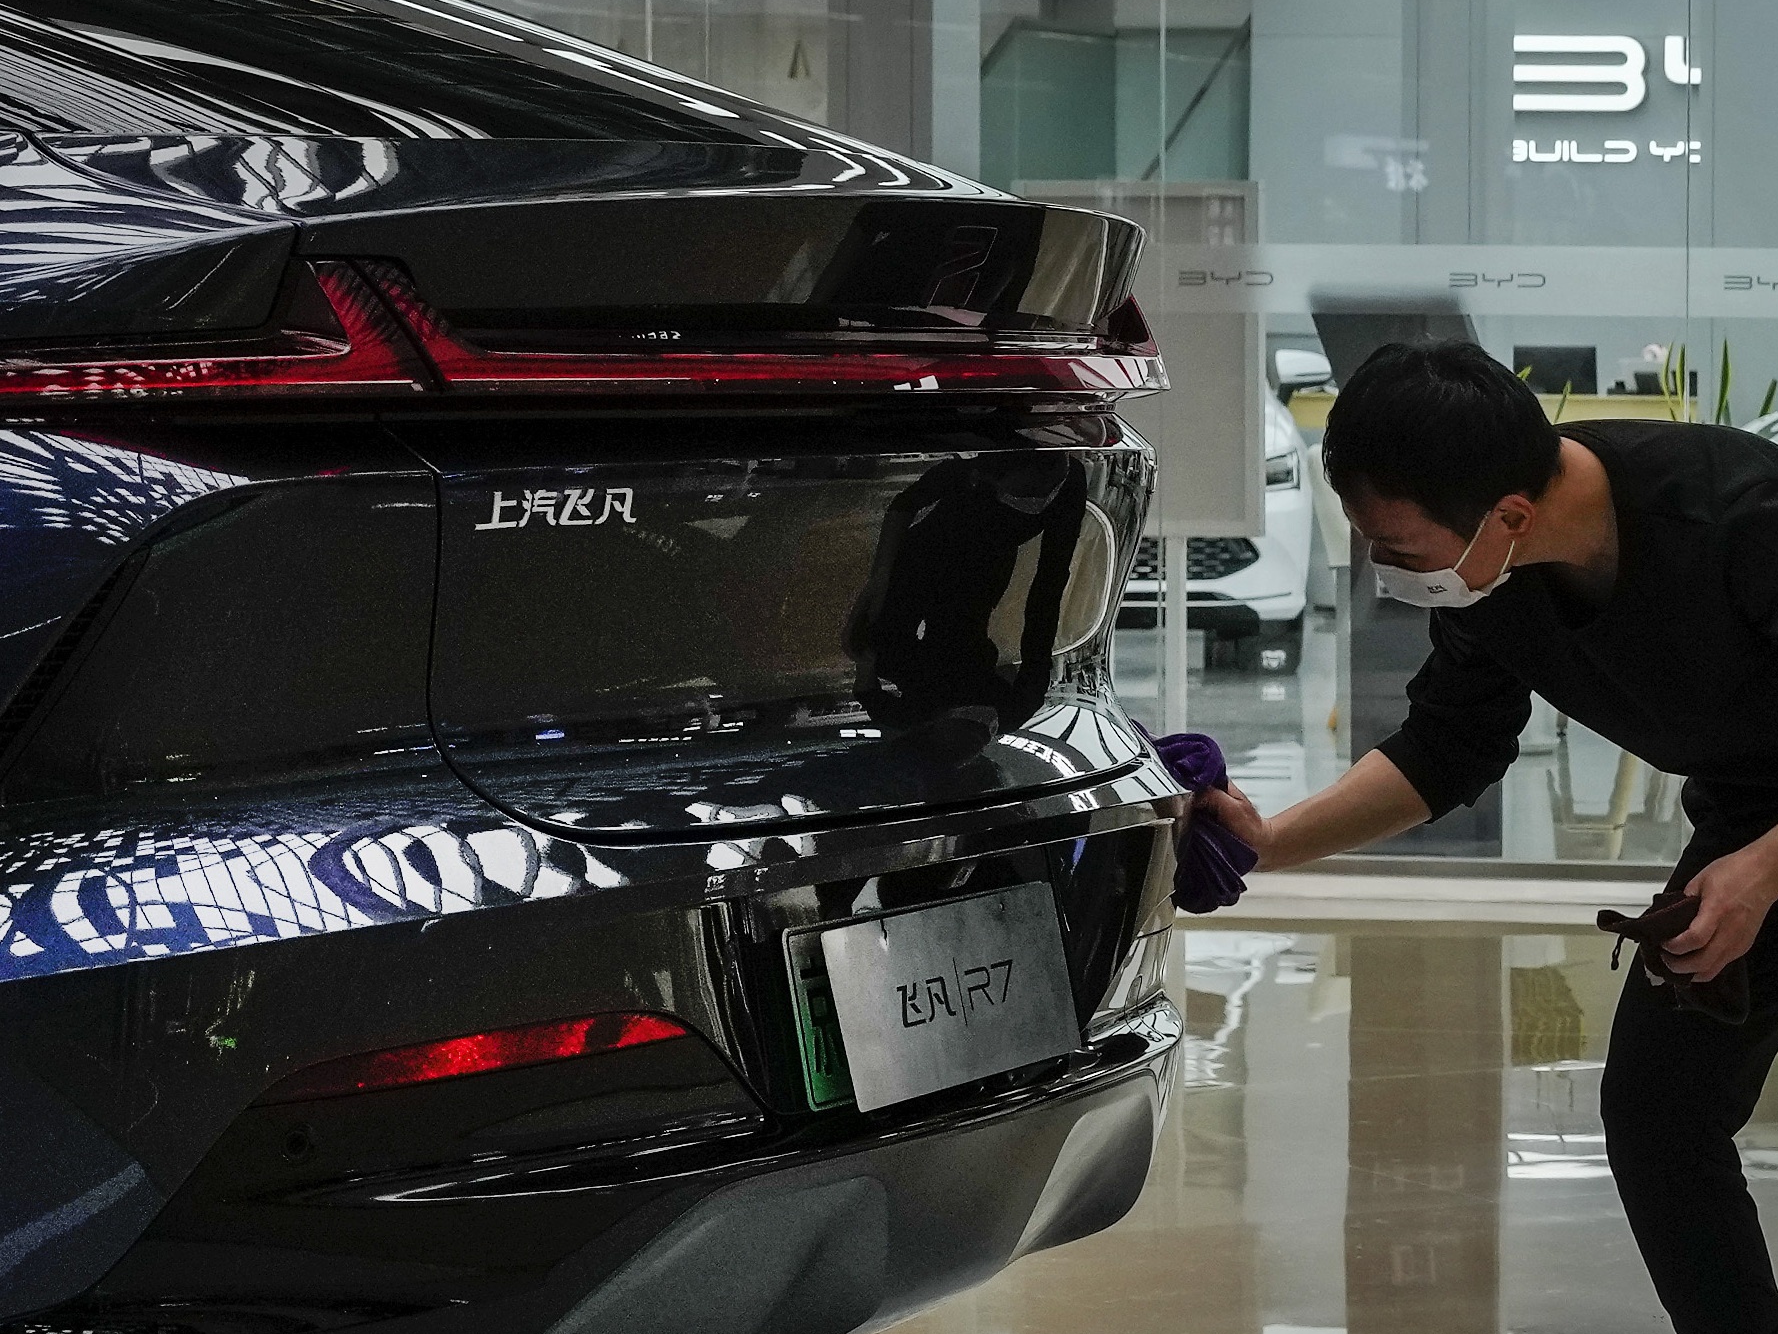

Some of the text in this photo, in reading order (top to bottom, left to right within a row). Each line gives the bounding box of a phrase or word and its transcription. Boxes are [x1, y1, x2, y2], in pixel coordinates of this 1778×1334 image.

[1178, 270, 1274, 287] BYD
[1448, 272, 1546, 289] BYD
[474, 487, 637, 531] 上汽飞凡
